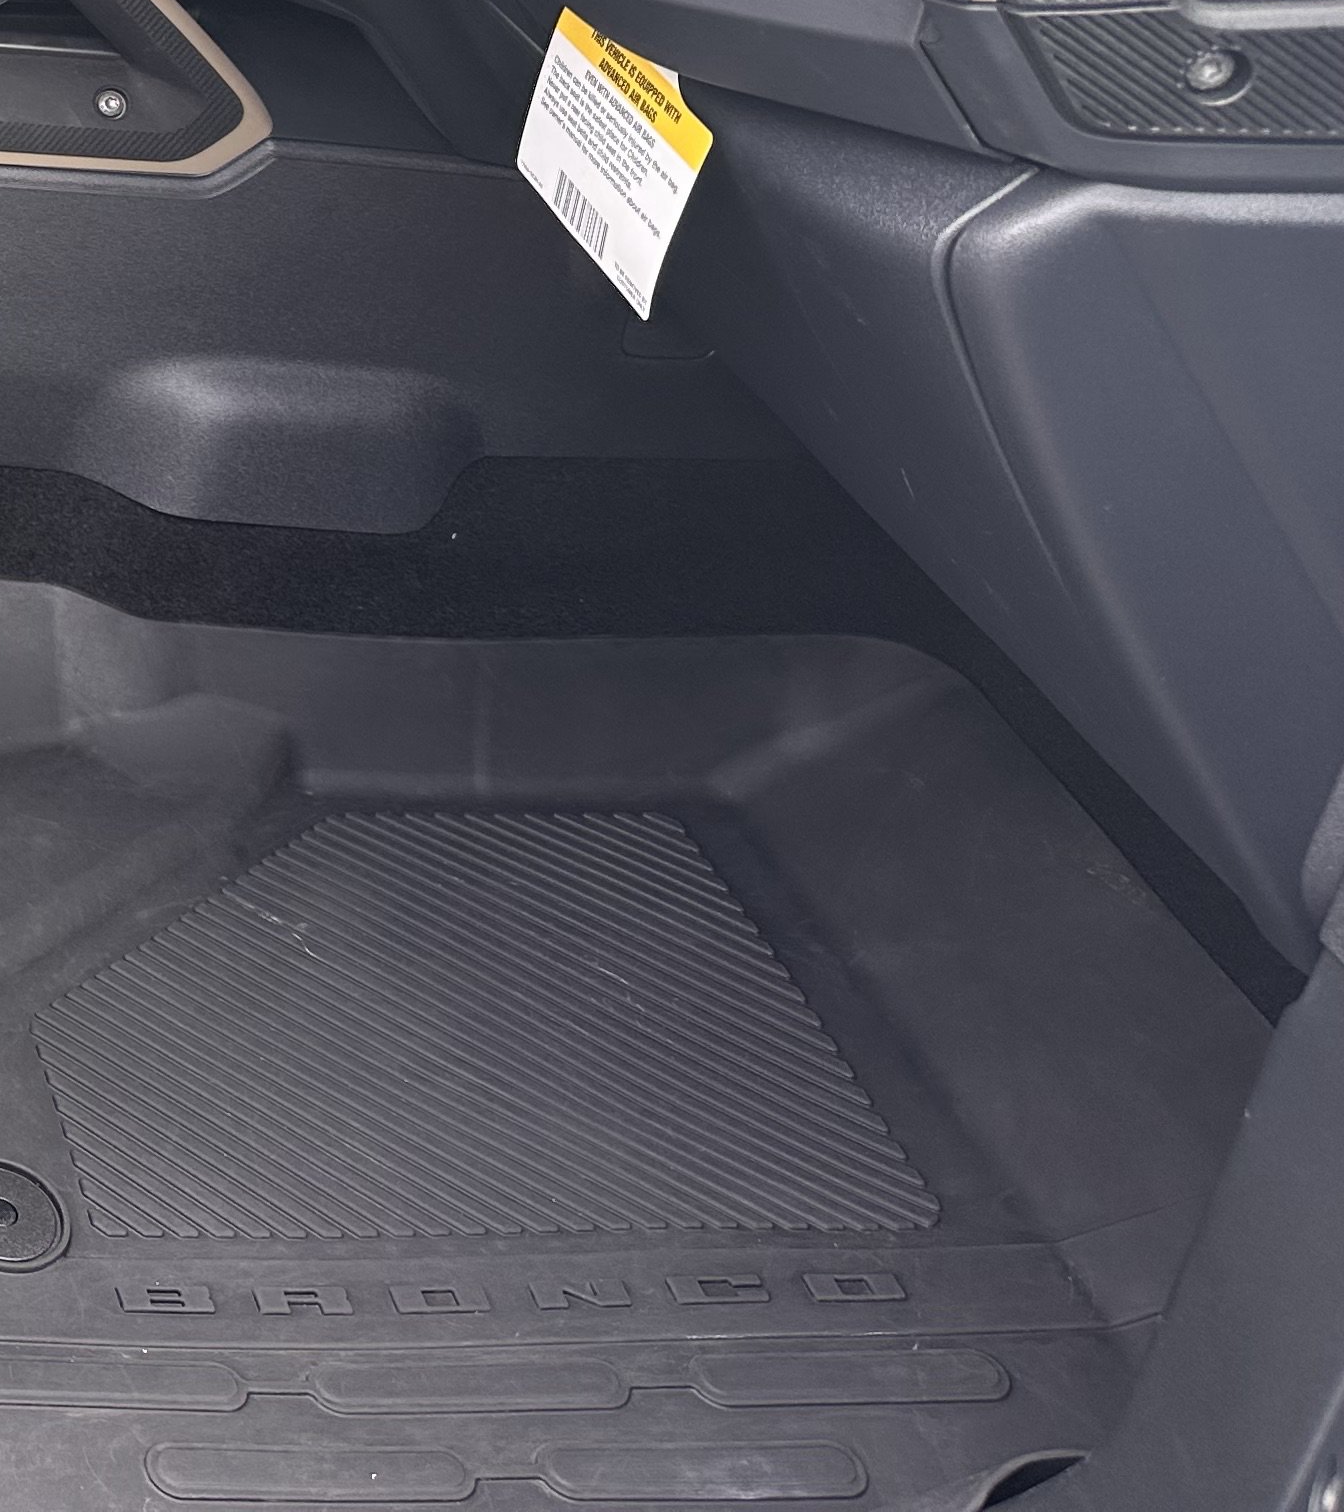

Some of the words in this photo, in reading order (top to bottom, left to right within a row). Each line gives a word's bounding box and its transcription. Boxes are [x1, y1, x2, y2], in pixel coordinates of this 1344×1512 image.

[584, 69, 598, 87] EVEN
[596, 82, 610, 100] WITH
[608, 94, 634, 125] ADVANCED
[632, 119, 642, 134] AIR
[640, 128, 656, 148] BAGS
[591, 27, 606, 48] THIS
[604, 40, 630, 72] VEHICLE
[627, 64, 637, 78] IS
[634, 70, 665, 107] EQUIPPED
[663, 100, 682, 124] WITH
[598, 56, 631, 95] ADVANCED
[628, 88, 641, 106] AIR
[639, 99, 658, 123] BAGS
[116, 1271, 908, 1317] BRONCO
